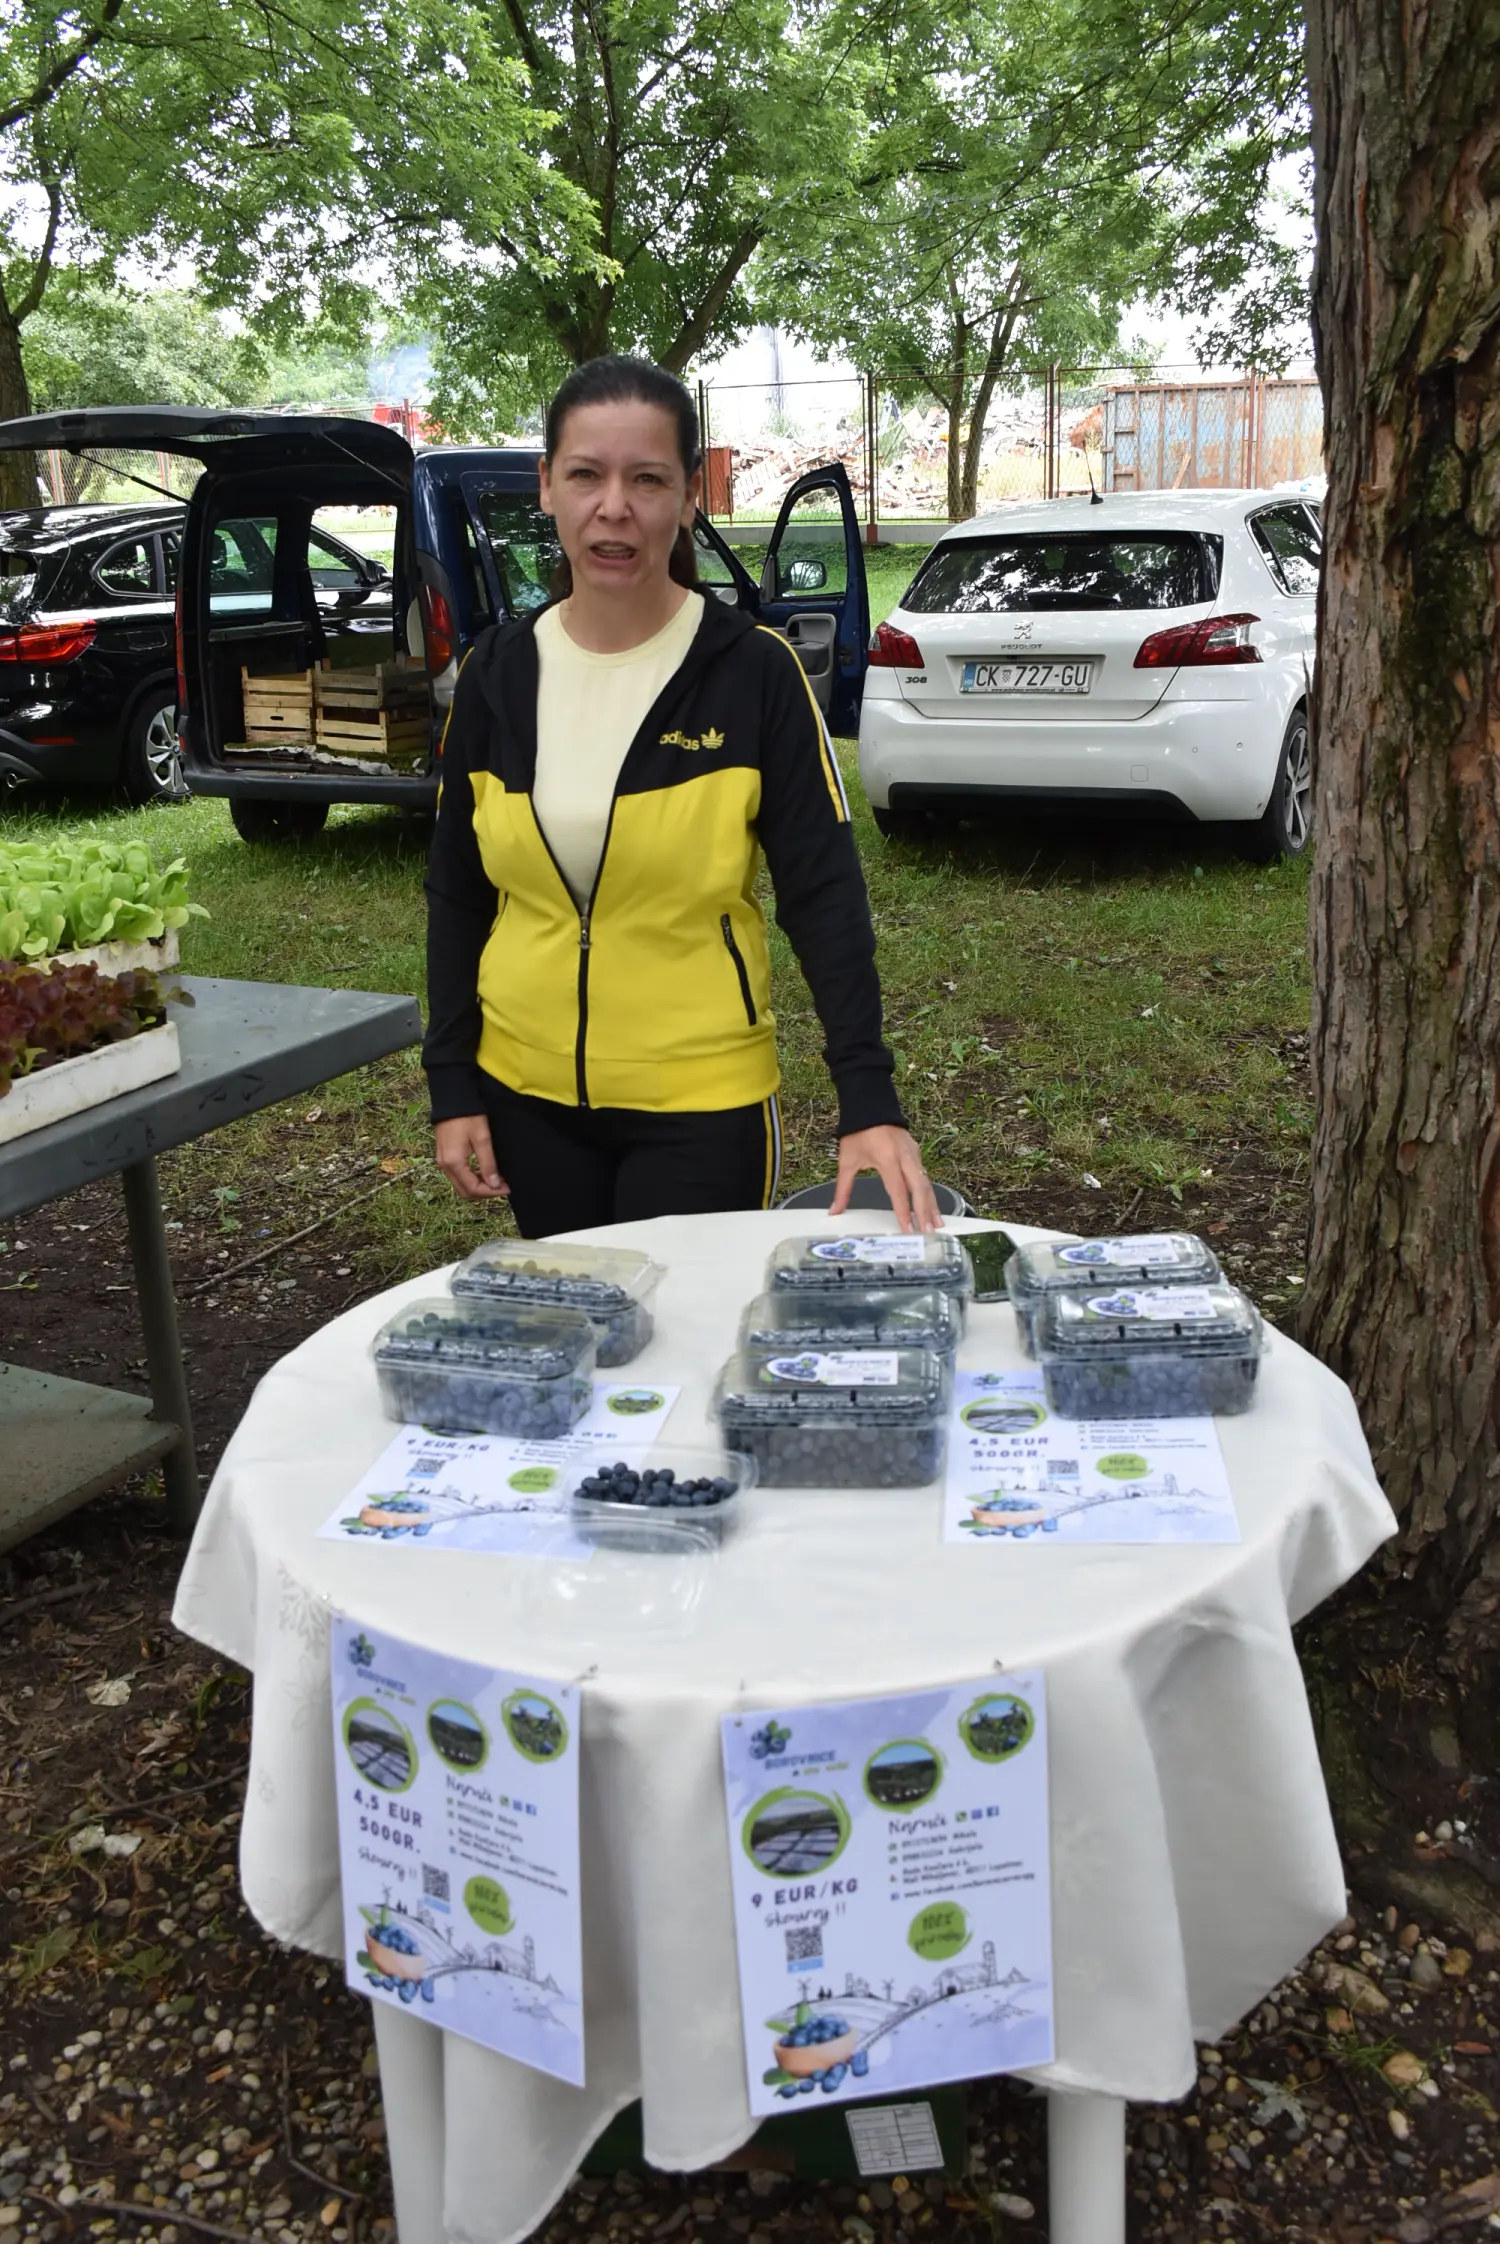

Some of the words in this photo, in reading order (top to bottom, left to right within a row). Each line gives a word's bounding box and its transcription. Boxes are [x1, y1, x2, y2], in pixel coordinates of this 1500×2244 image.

[904, 676, 928, 684] 308
[659, 730, 700, 751] adidas
[1010, 1436, 1050, 1445] EUR
[388, 1801, 423, 1828] EUR
[751, 1893, 763, 1908] 9
[773, 1878, 859, 1905] EUR/KG
